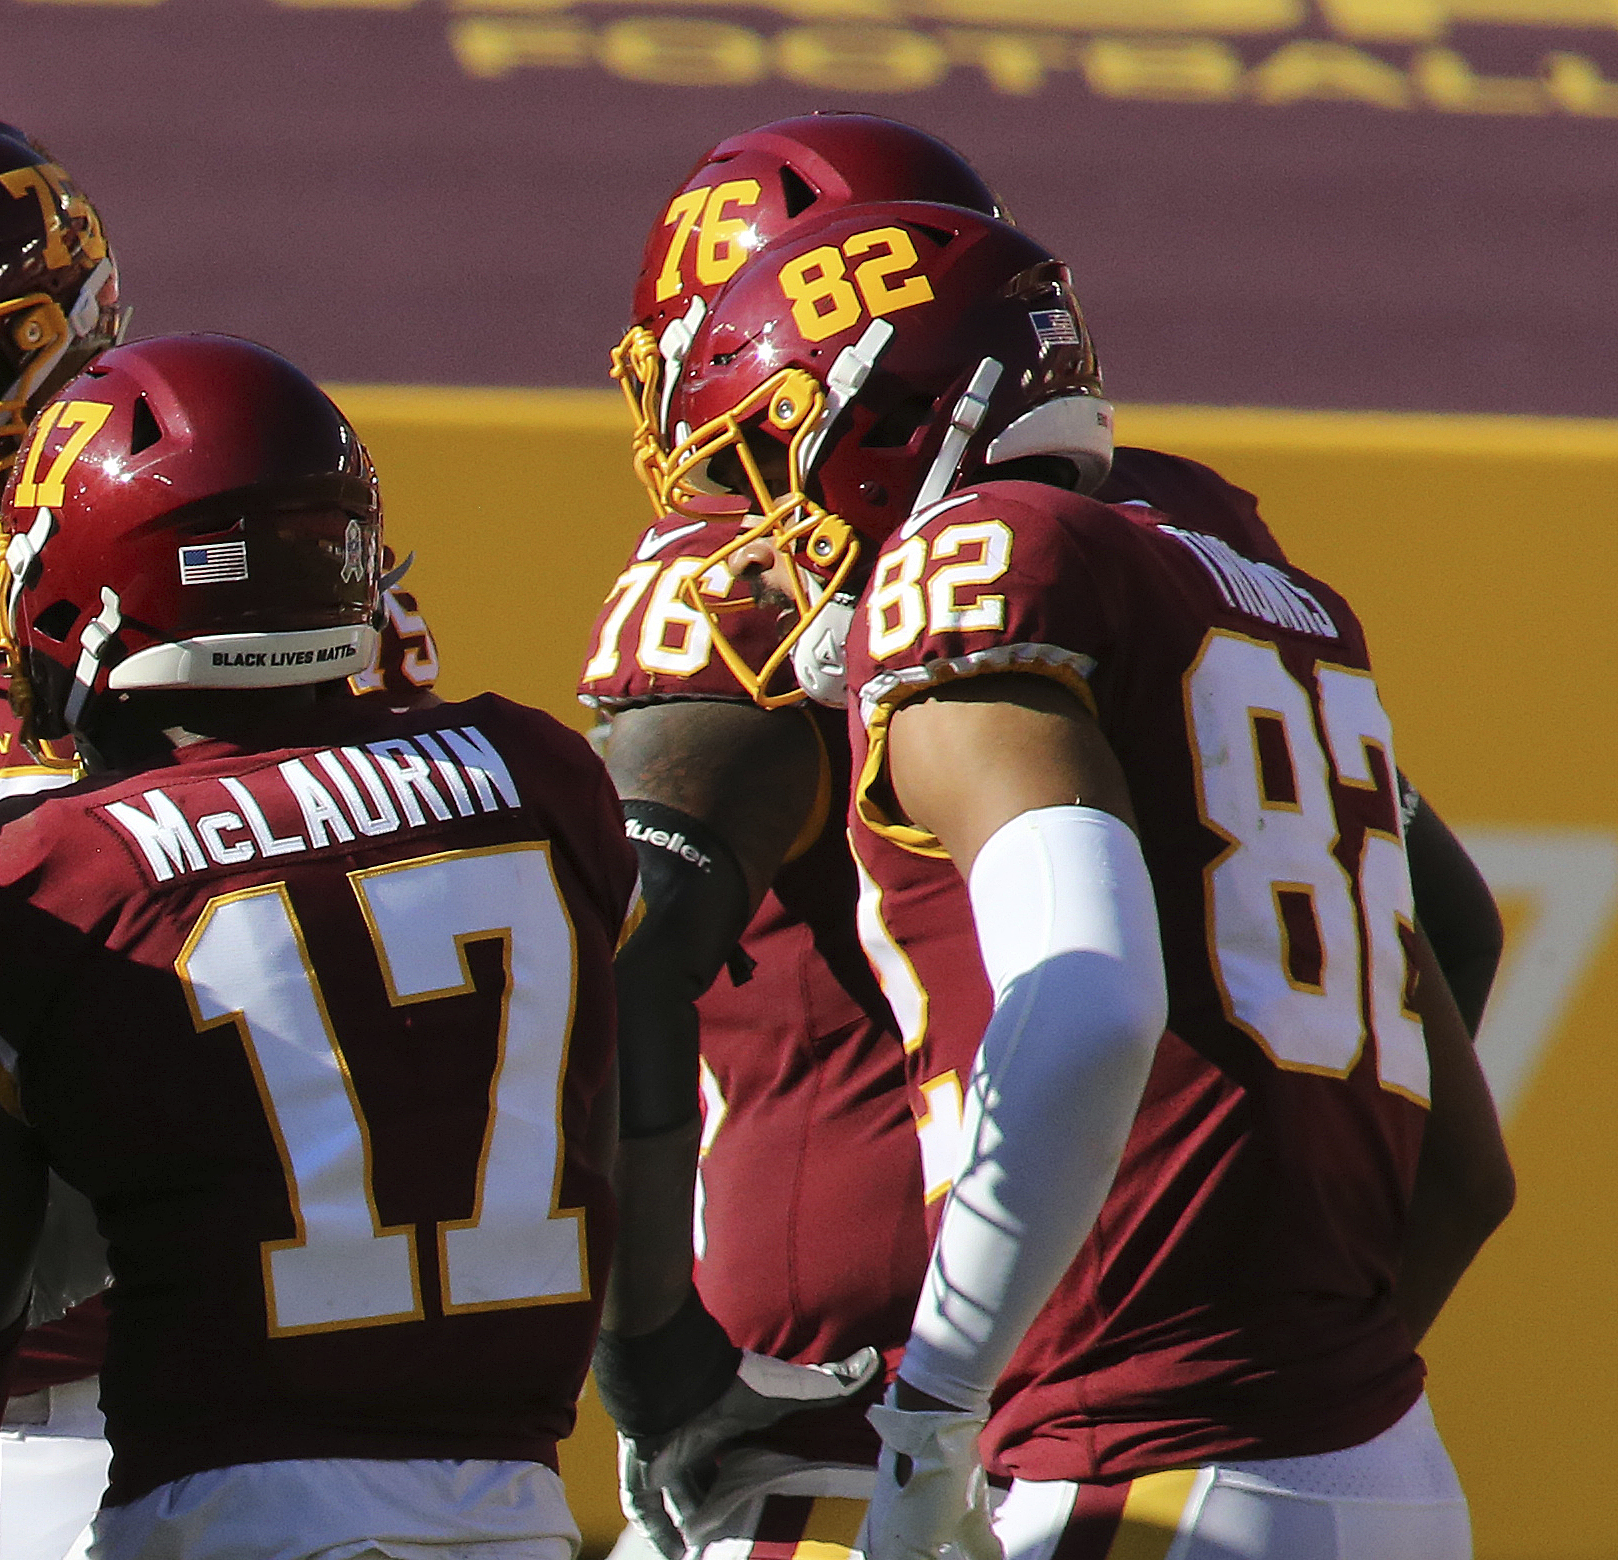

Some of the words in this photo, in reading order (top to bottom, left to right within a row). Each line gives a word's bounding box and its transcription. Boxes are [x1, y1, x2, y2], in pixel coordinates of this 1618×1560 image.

[655, 178, 762, 302] 76
[778, 226, 935, 343] 82
[14, 402, 113, 508] 17
[587, 557, 733, 680] 76
[867, 519, 1013, 660] 82
[212, 652, 266, 667] BLACK
[270, 650, 314, 667] LIVES
[316, 643, 357, 662] MATT
[104, 725, 522, 882] McLAURIN
[1182, 626, 1433, 1111] 82
[173, 839, 593, 1340] 17
